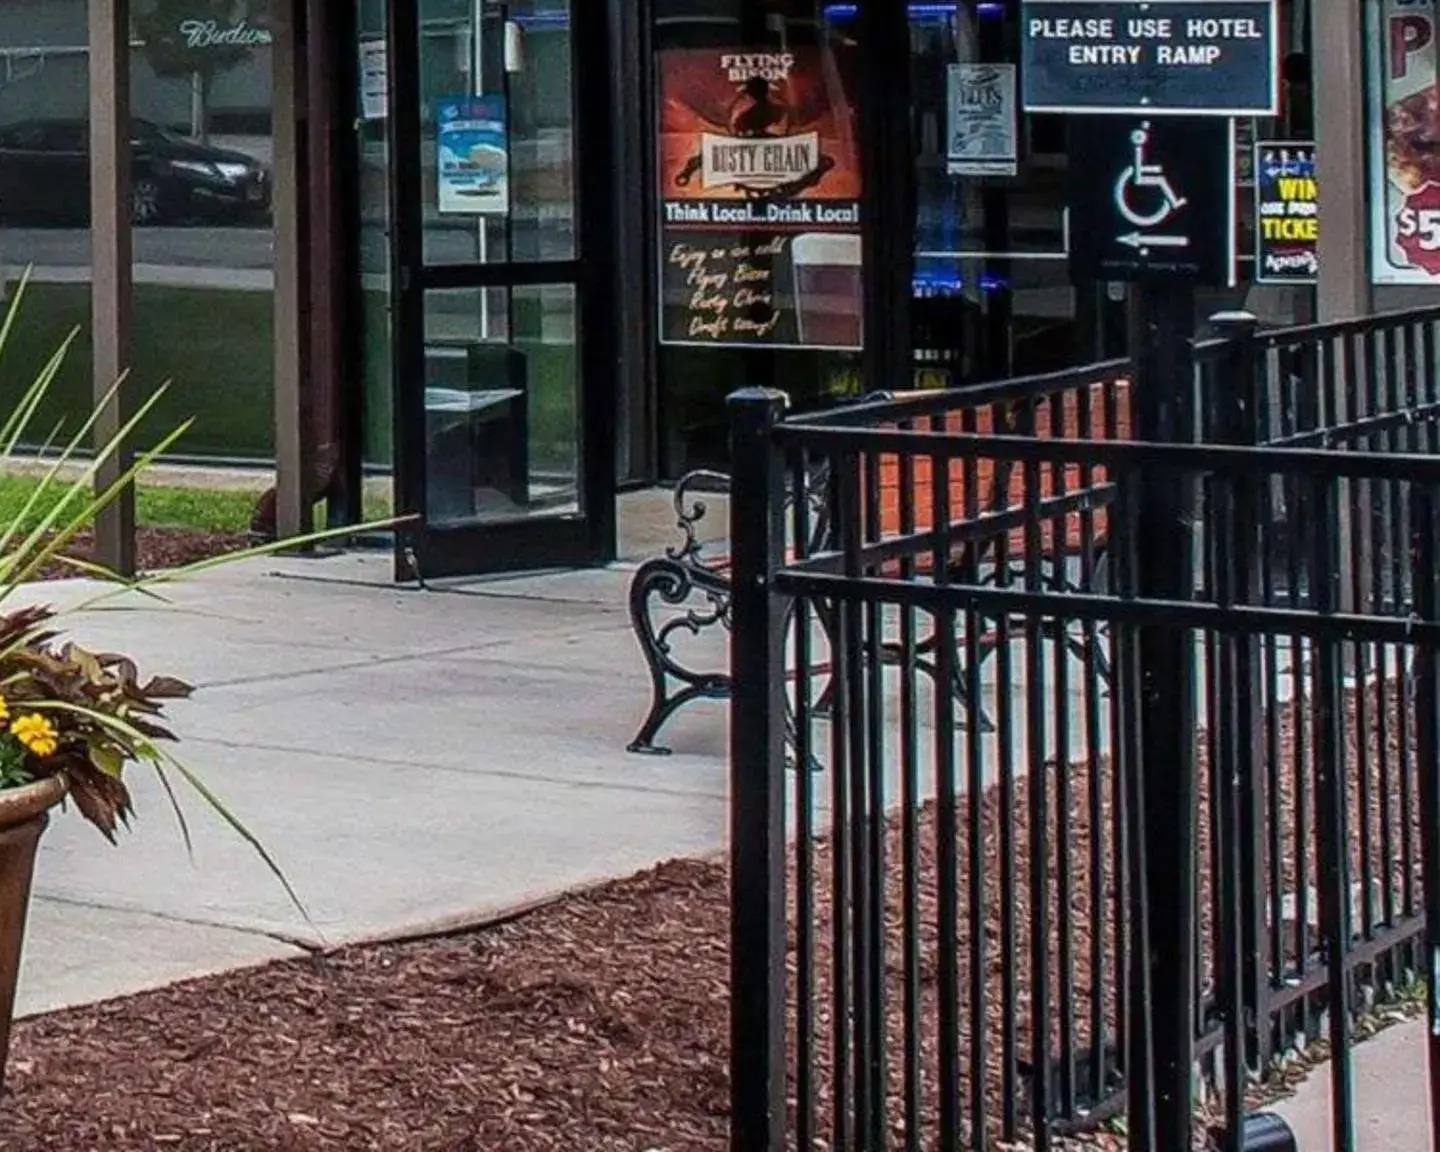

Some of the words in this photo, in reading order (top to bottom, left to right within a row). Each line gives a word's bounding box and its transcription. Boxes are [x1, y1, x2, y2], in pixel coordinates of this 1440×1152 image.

[1029, 18, 1113, 39] PLEASE
[1127, 18, 1173, 39] USE
[1186, 18, 1262, 39] HOTEL
[721, 53, 795, 69] FLYING
[1068, 44, 1142, 66] ENTRY
[1156, 44, 1222, 66] RAMP
[763, 143, 811, 173] CHAIN
[665, 202, 709, 222] Think
[815, 202, 859, 223] Local
